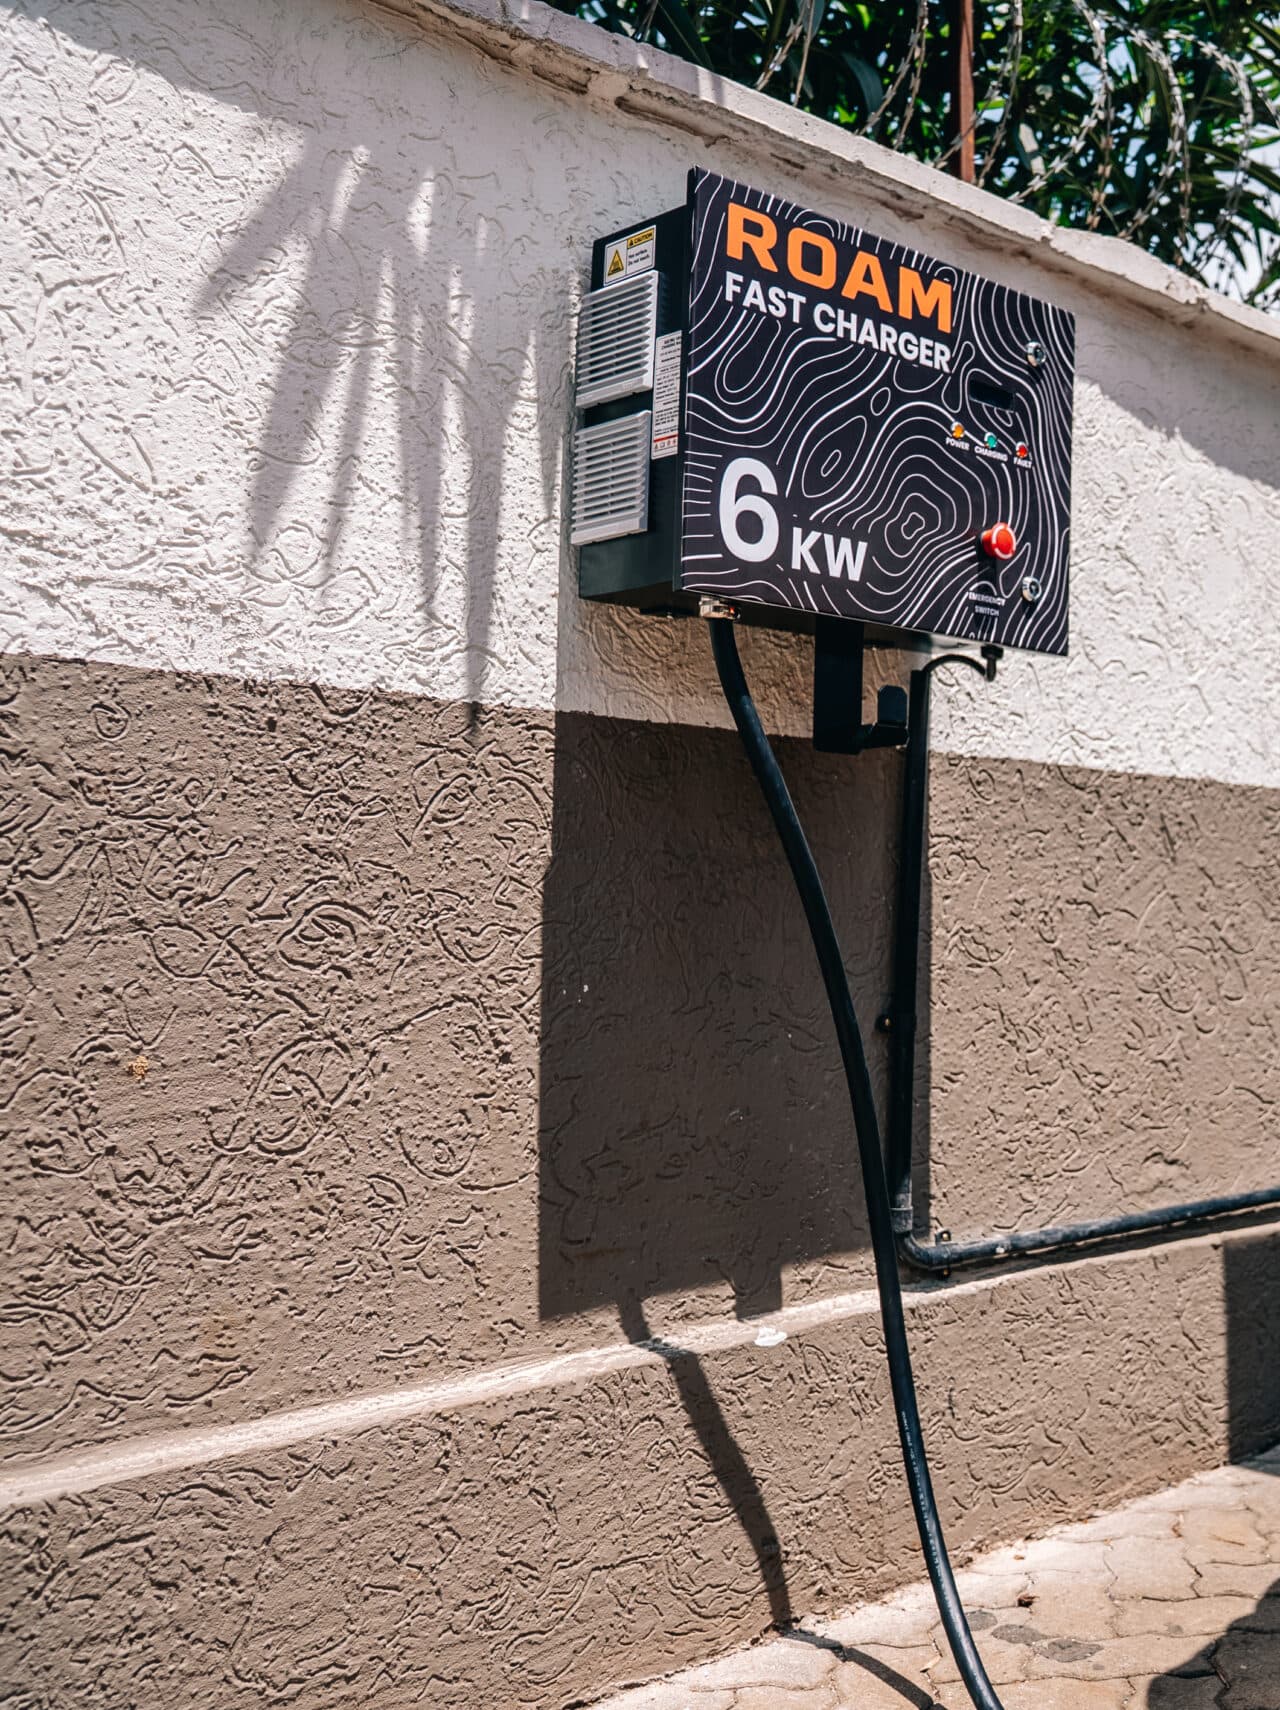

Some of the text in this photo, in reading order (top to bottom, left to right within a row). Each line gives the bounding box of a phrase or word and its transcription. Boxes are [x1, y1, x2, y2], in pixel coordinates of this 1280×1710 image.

[726, 202, 952, 334] ROAM
[725, 271, 951, 373] FAST CHARGER
[945, 437, 970, 451] POWER
[974, 446, 1008, 462] CHARGING
[1013, 457, 1032, 469] FAULT
[719, 457, 868, 582] 6 KW
[969, 592, 1005, 606] EMERGENCY
[975, 605, 999, 617] SWITCH
